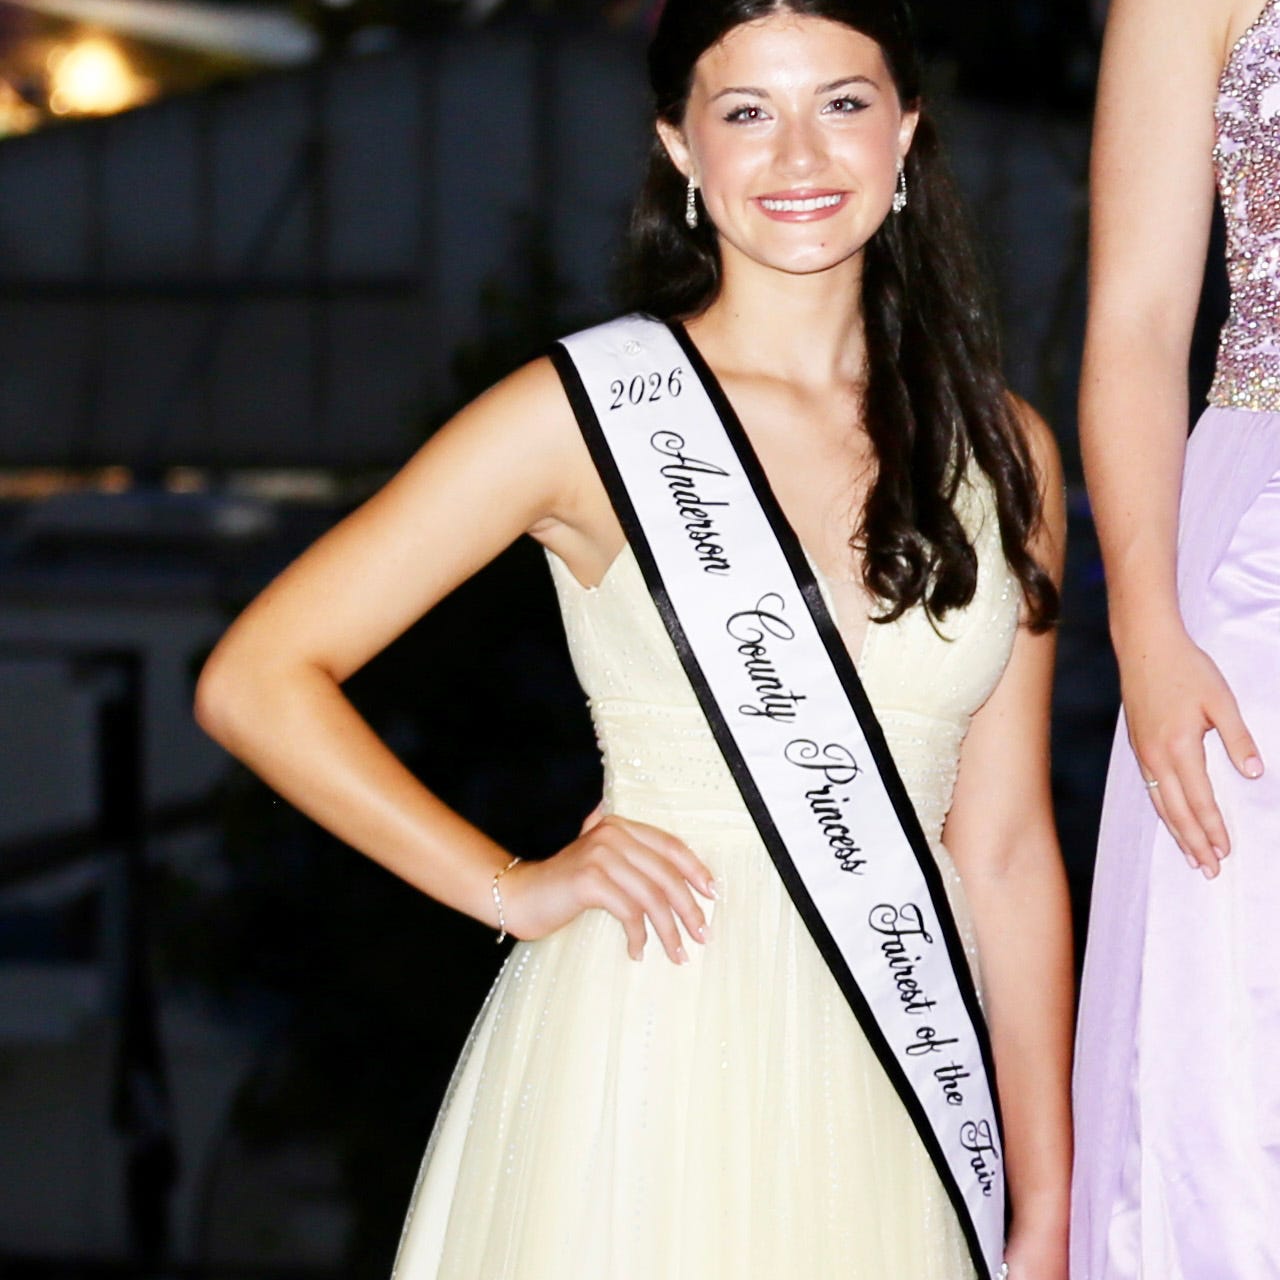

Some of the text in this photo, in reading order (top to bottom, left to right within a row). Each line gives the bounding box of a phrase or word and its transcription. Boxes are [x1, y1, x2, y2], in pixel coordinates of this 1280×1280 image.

[608, 366, 683, 412] 2026
[649, 429, 1000, 1199] Anderson County Princess Fairest of the Fair
